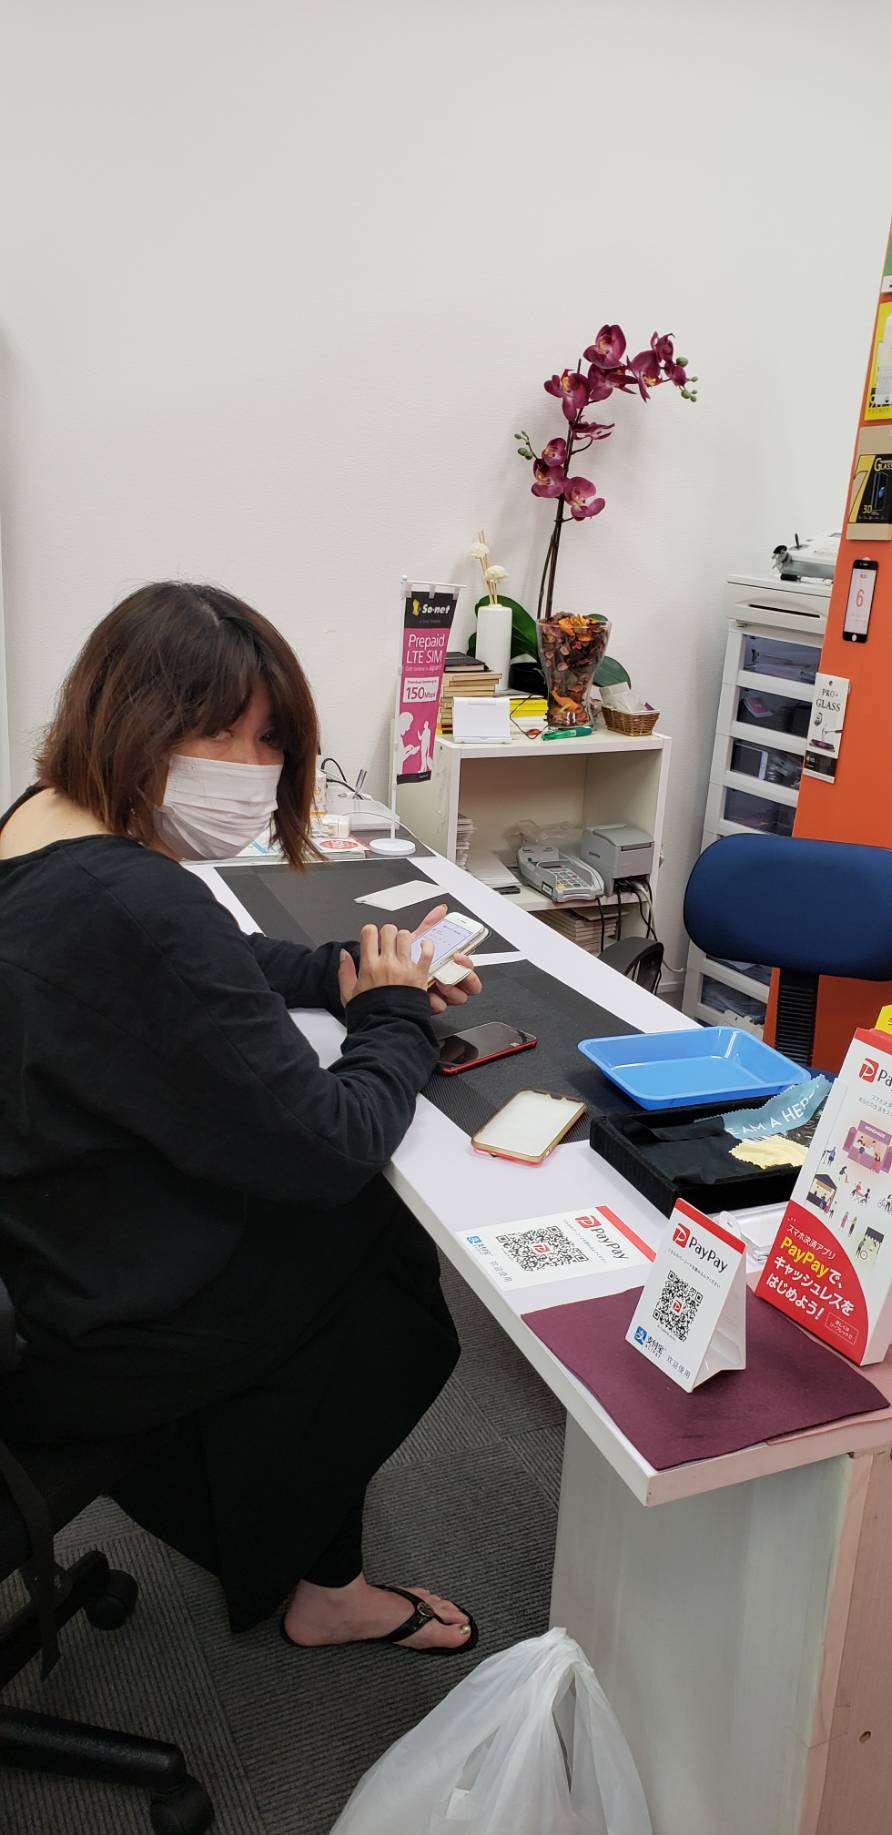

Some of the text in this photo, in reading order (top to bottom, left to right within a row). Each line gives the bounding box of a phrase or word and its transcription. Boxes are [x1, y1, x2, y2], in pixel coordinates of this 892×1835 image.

[856, 589, 865, 607] 6
[408, 633, 446, 650] Prepaid
[406, 650, 443, 664] LTE SIM
[815, 698, 841, 712] GLASS
[769, 1117, 783, 1129] A
[590, 1227, 629, 1259] PayPay
[688, 1236, 728, 1273] PayPay
[773, 1256, 855, 1317] キャッシュレスを
